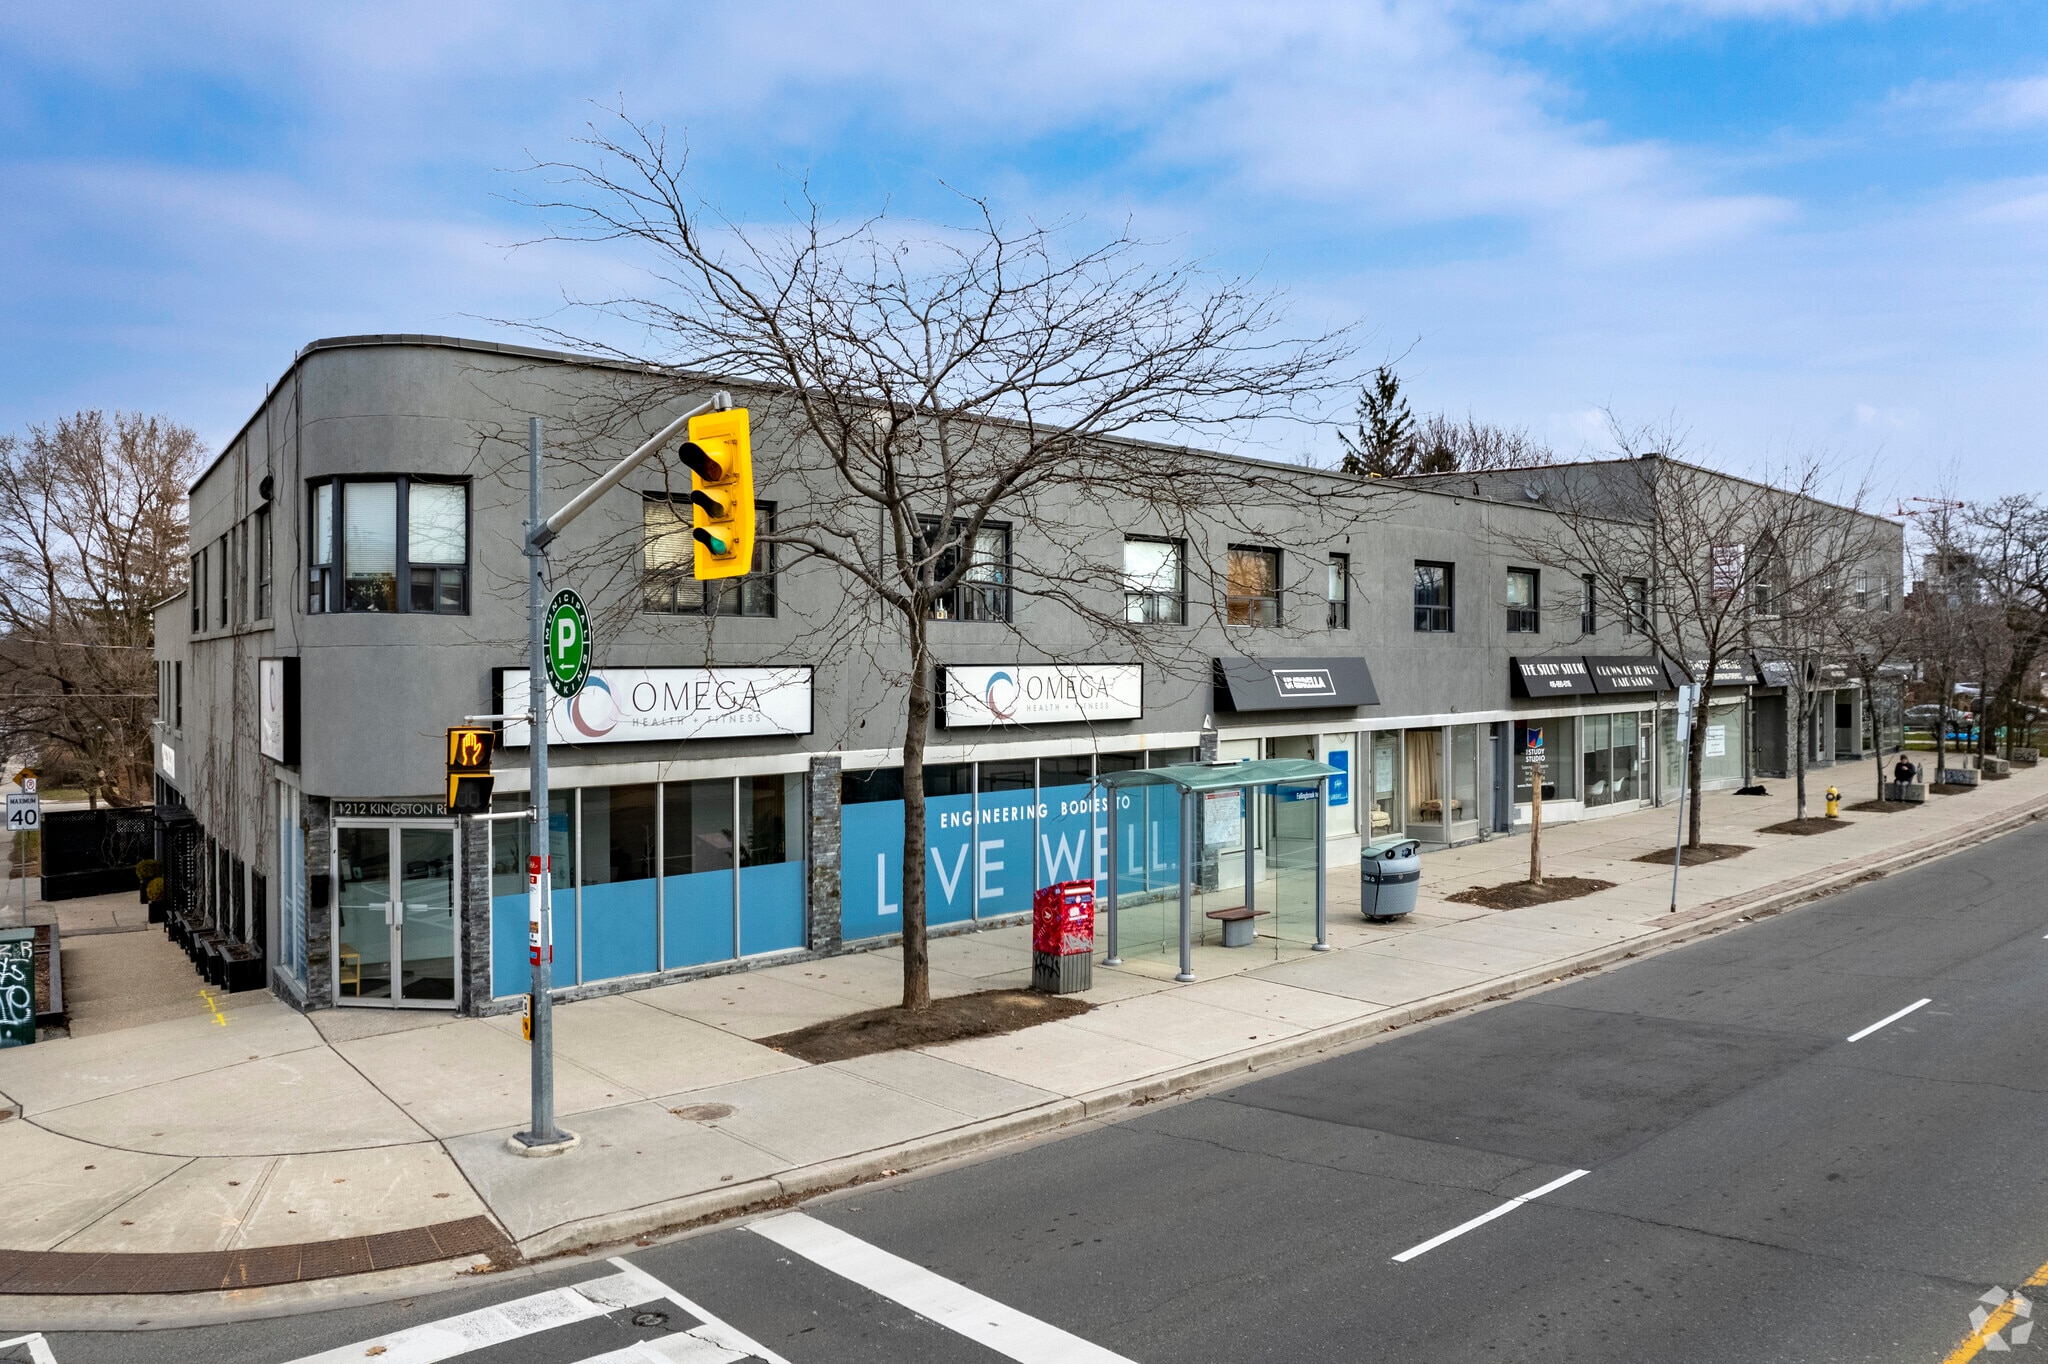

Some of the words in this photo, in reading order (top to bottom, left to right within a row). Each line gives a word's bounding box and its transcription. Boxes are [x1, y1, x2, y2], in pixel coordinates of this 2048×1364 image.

[545, 594, 588, 640] MUNICIPAL
[558, 618, 576, 659] P
[545, 654, 588, 694] PARKING
[1520, 664, 1538, 676] THE
[1537, 664, 1559, 676] STUDY
[1561, 662, 1587, 675] STUDIO
[632, 680, 761, 713] OMEGA
[1026, 675, 1109, 701] OMEGA
[1026, 703, 1060, 712] HEALTH
[632, 716, 684, 727] HEALTH
[707, 713, 761, 725] FITNESS
[1525, 755, 1546, 763] STUDIO
[1528, 748, 1545, 756] STUDY
[10, 809, 37, 826] 40
[338, 803, 366, 815] 1212
[370, 803, 433, 815] KINGSTON
[436, 803, 447, 815] R
[940, 803, 1049, 829] ENGINEERING
[1061, 796, 1108, 816] BODIES
[1116, 795, 1131, 809] TO
[877, 838, 1006, 916] LVE
